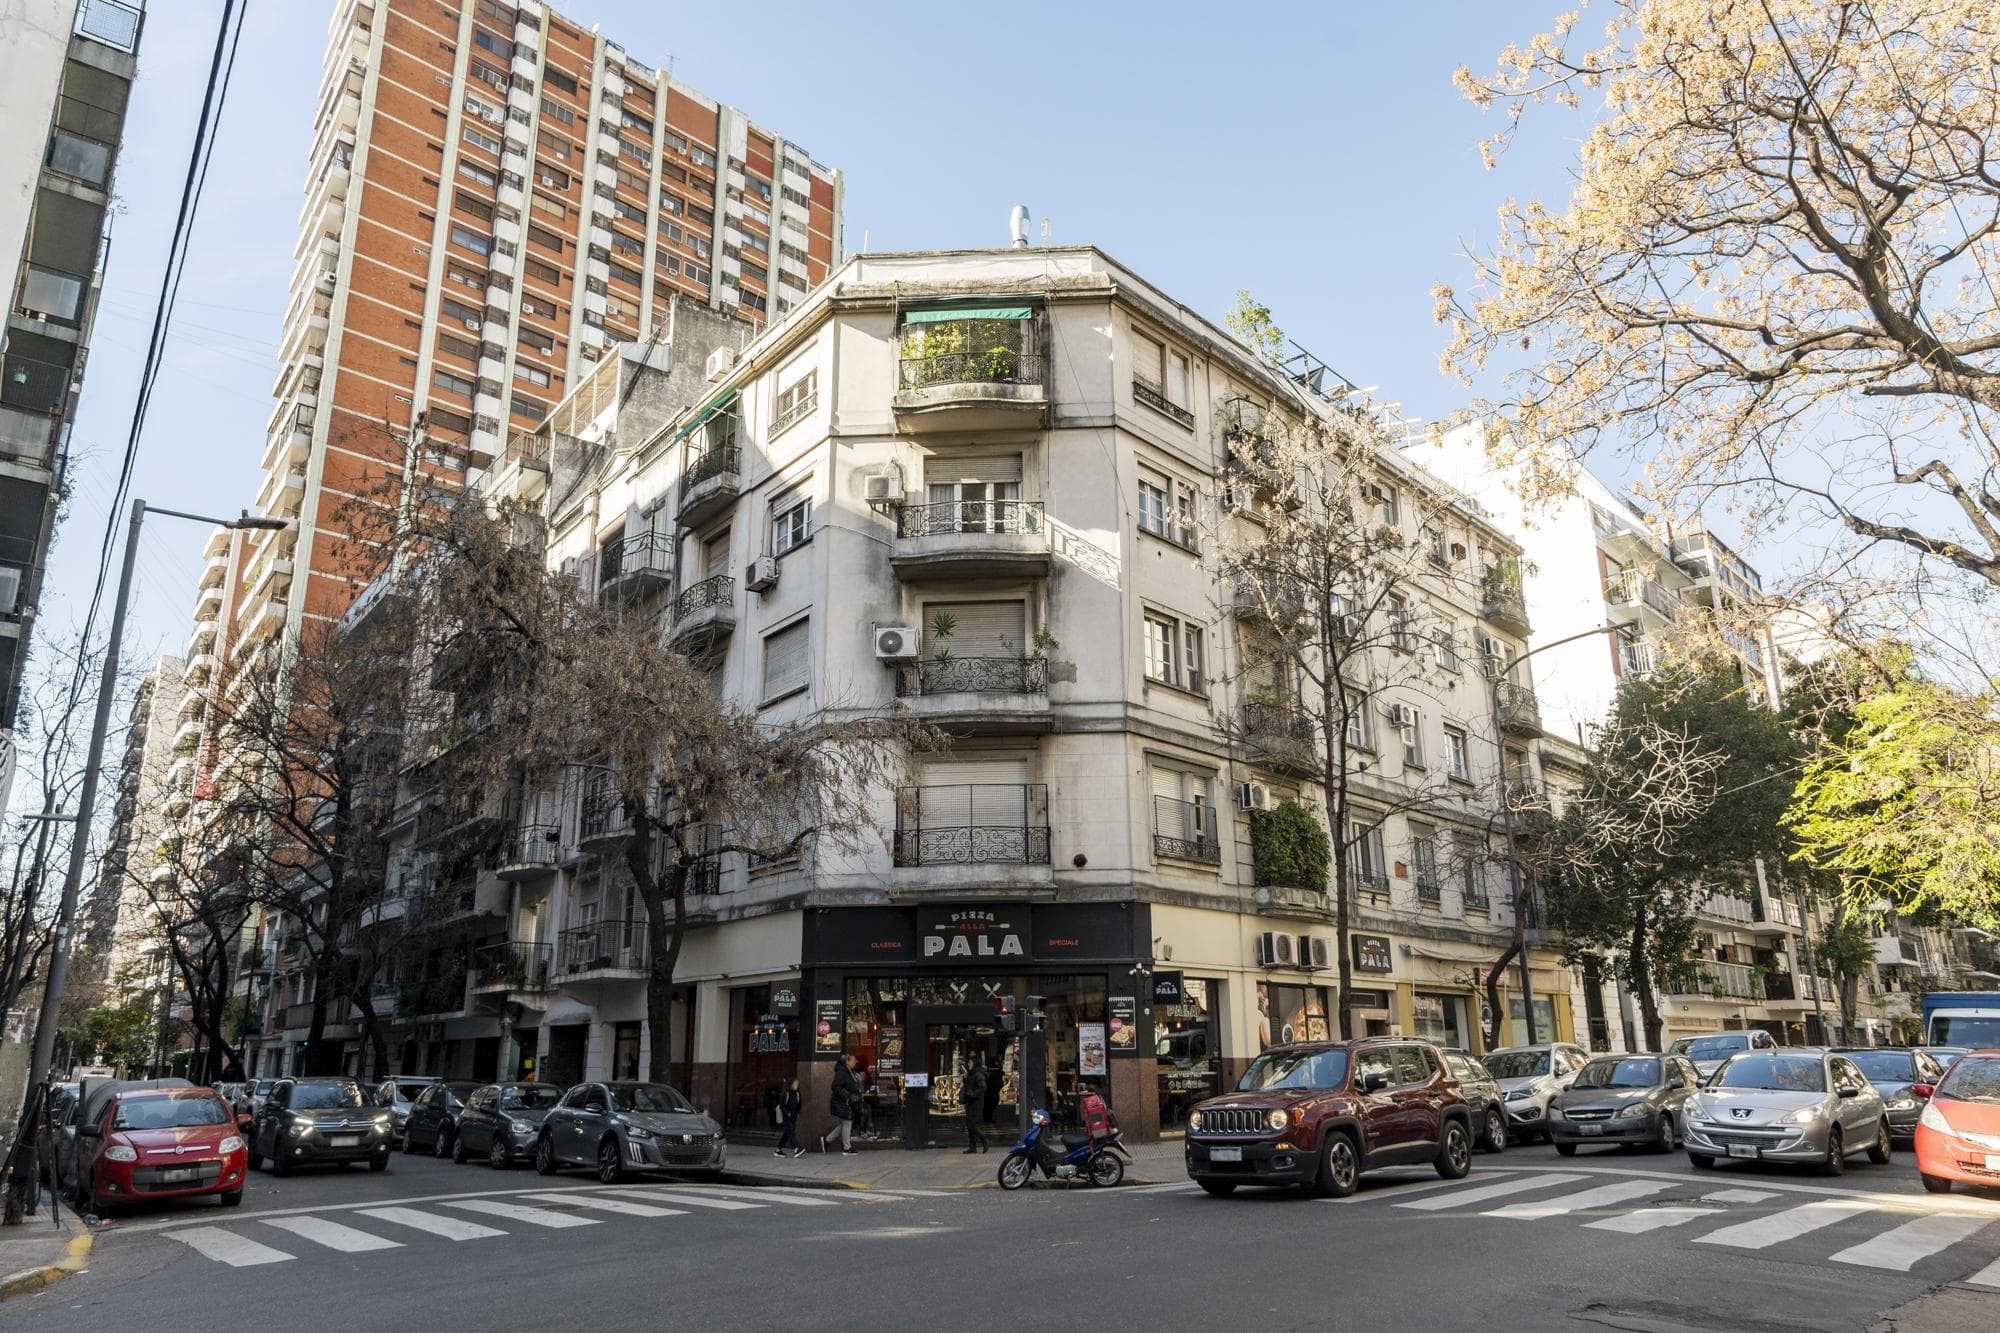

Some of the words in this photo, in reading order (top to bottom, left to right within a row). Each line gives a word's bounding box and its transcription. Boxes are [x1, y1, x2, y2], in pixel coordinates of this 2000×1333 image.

[951, 911, 994, 921] PIZZA
[870, 941, 902, 949] CLASSICA
[924, 934, 1024, 957] PALA
[1049, 938, 1080, 946] SPECIALE
[1360, 952, 1390, 968] PALA
[1155, 987, 1178, 995] PALA
[774, 994, 797, 1002] PALA
[1166, 1004, 1198, 1017] PALA
[749, 1032, 790, 1052] PALA
